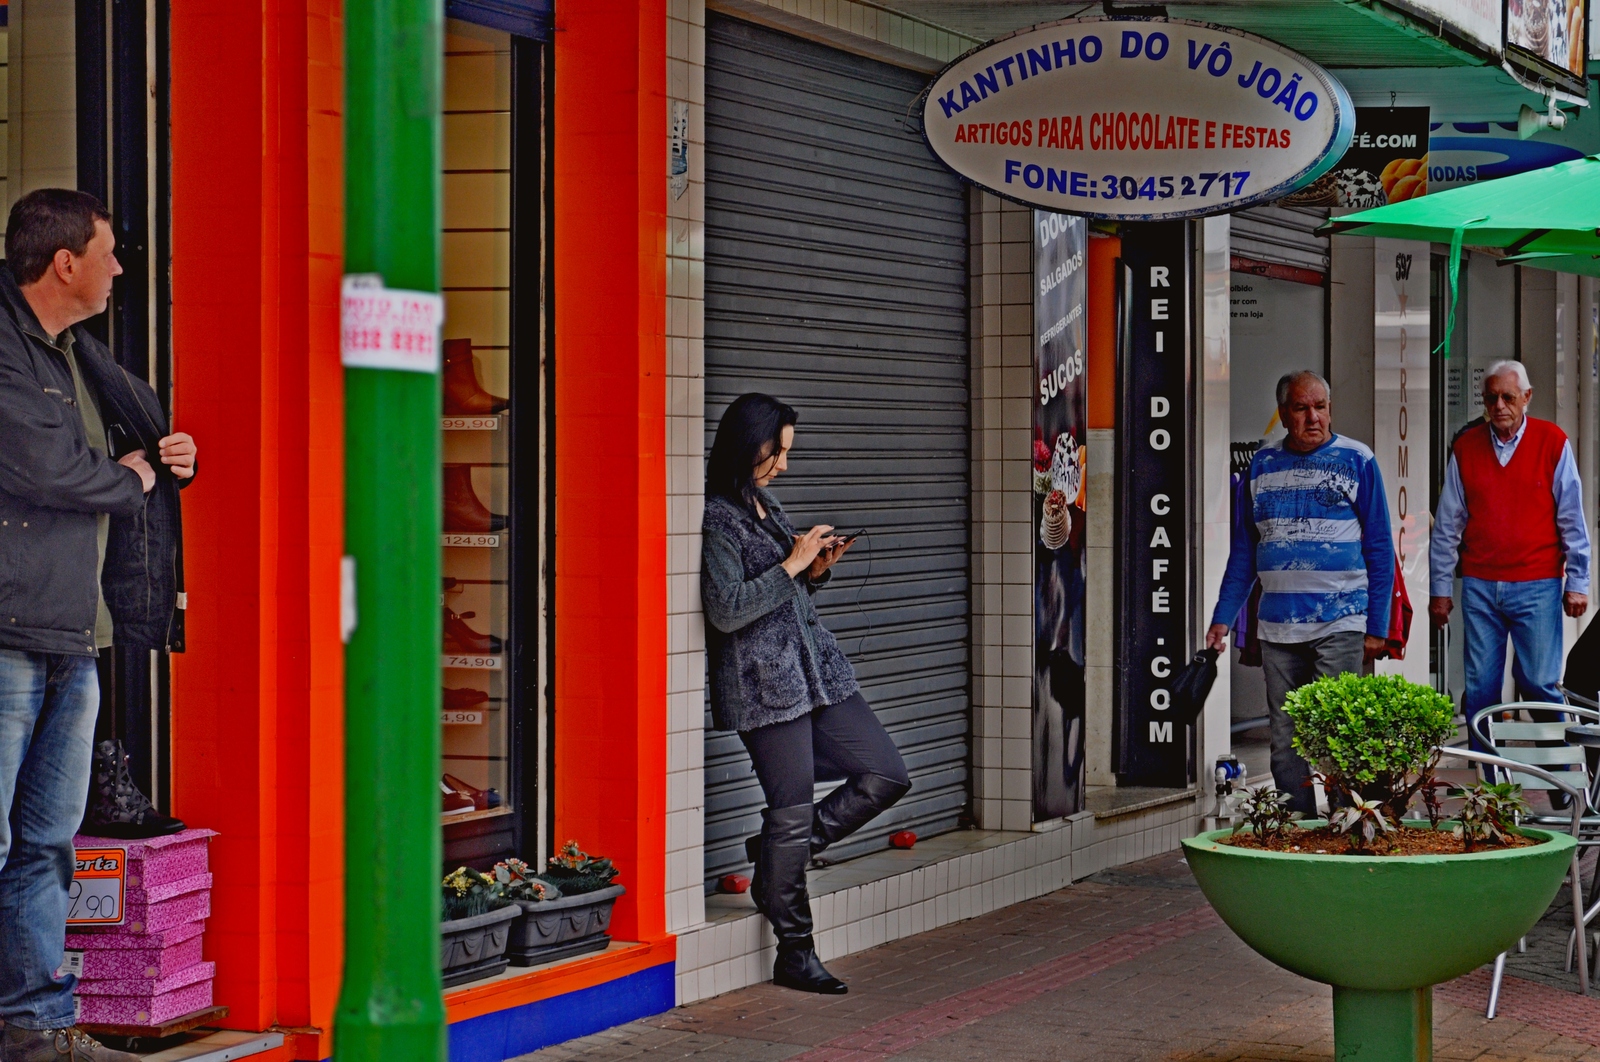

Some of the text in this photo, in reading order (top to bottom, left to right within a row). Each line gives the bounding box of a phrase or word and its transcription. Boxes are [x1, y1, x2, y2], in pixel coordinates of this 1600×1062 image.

[938, 31, 1318, 121] KANTINHO DO VÔ JOÃO
[955, 112, 1291, 150] ARTIGOS PARA CHOCOLATE E FESTAS
[1040, 212, 1082, 248] DOC
[1040, 250, 1083, 296] SALGADOS
[1395, 252, 1412, 281] 597
[1040, 303, 1083, 347] REFRIGERANTES
[1150, 266, 1170, 352] REI
[1250, 311, 1264, 319] loja
[1040, 349, 1083, 406] SUCOS
[1149, 396, 1171, 450] DO
[75, 854, 119, 871] erta
